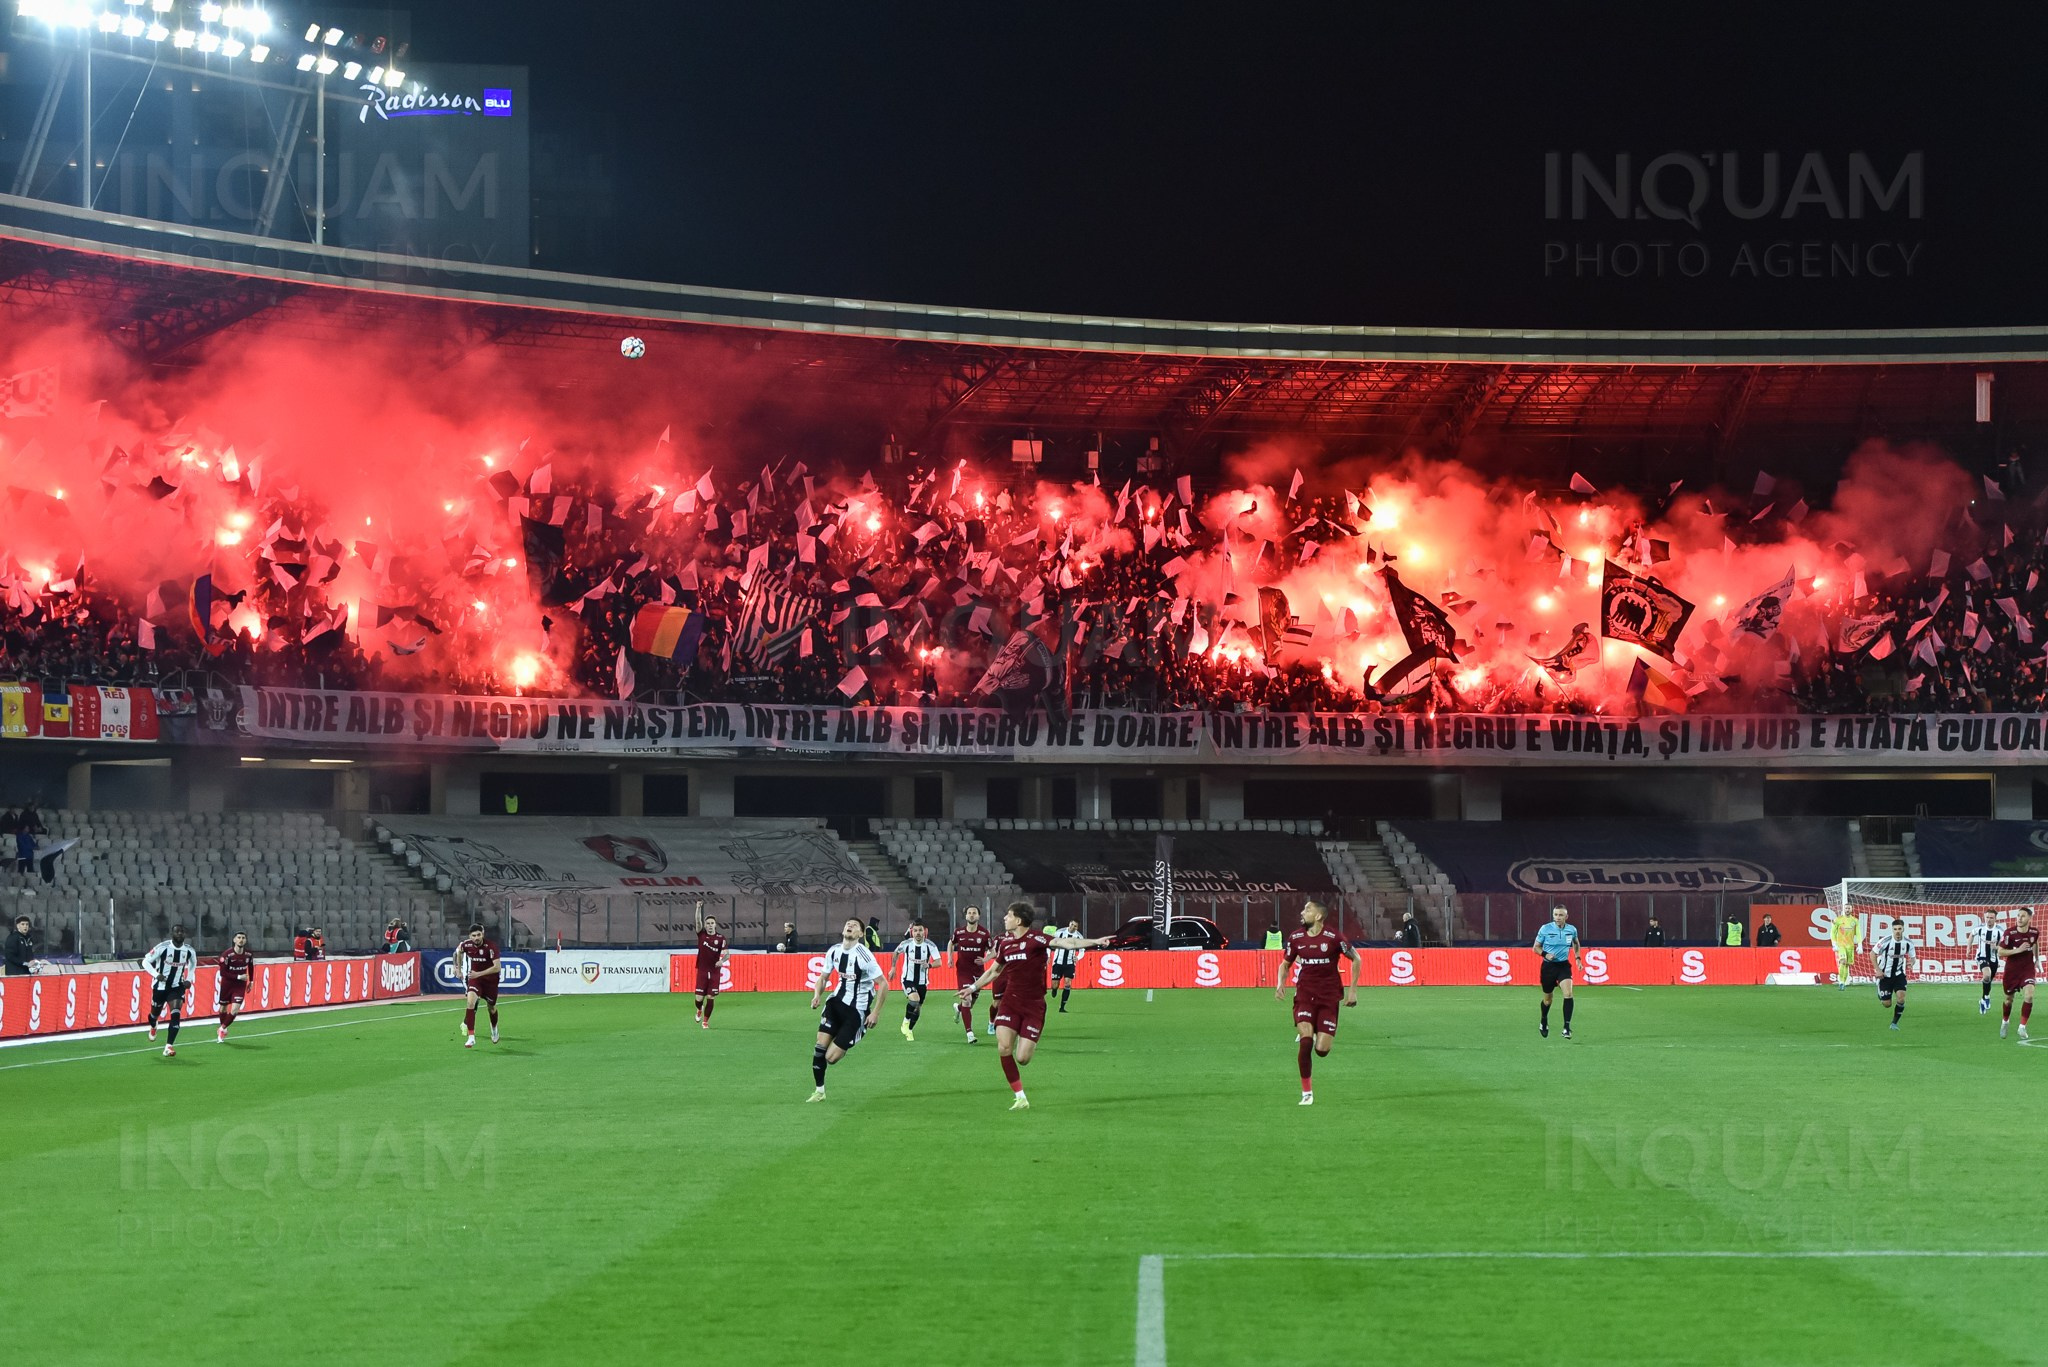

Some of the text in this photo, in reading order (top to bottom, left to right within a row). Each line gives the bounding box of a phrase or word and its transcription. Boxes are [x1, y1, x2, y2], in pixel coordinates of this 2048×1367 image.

[359, 81, 510, 123] Radisson BLU
[104, 690, 125, 700] RED
[101, 724, 128, 734] DOGS
[346, 696, 404, 734] ALB
[452, 701, 549, 739] NEGRU
[557, 705, 595, 740] NE
[835, 710, 893, 743] ALB
[939, 713, 1038, 747] NEGRU
[1047, 714, 1084, 747] NE
[1308, 717, 1365, 747] ALB
[1414, 717, 1516, 750] NEGRU
[1526, 719, 1541, 751] E
[1742, 718, 1800, 750] JUR
[1811, 718, 1826, 748] E
[1938, 717, 2048, 751] CULOA
[1131, 881, 1298, 893] COSILIUL LOCAL
[1153, 860, 1167, 935] AUTOKLASS
[381, 957, 415, 993] SUPERBET
[549, 966, 664, 975] BANCA BT TRANSILVANIA
[1919, 974, 1975, 983] SUPERBET
